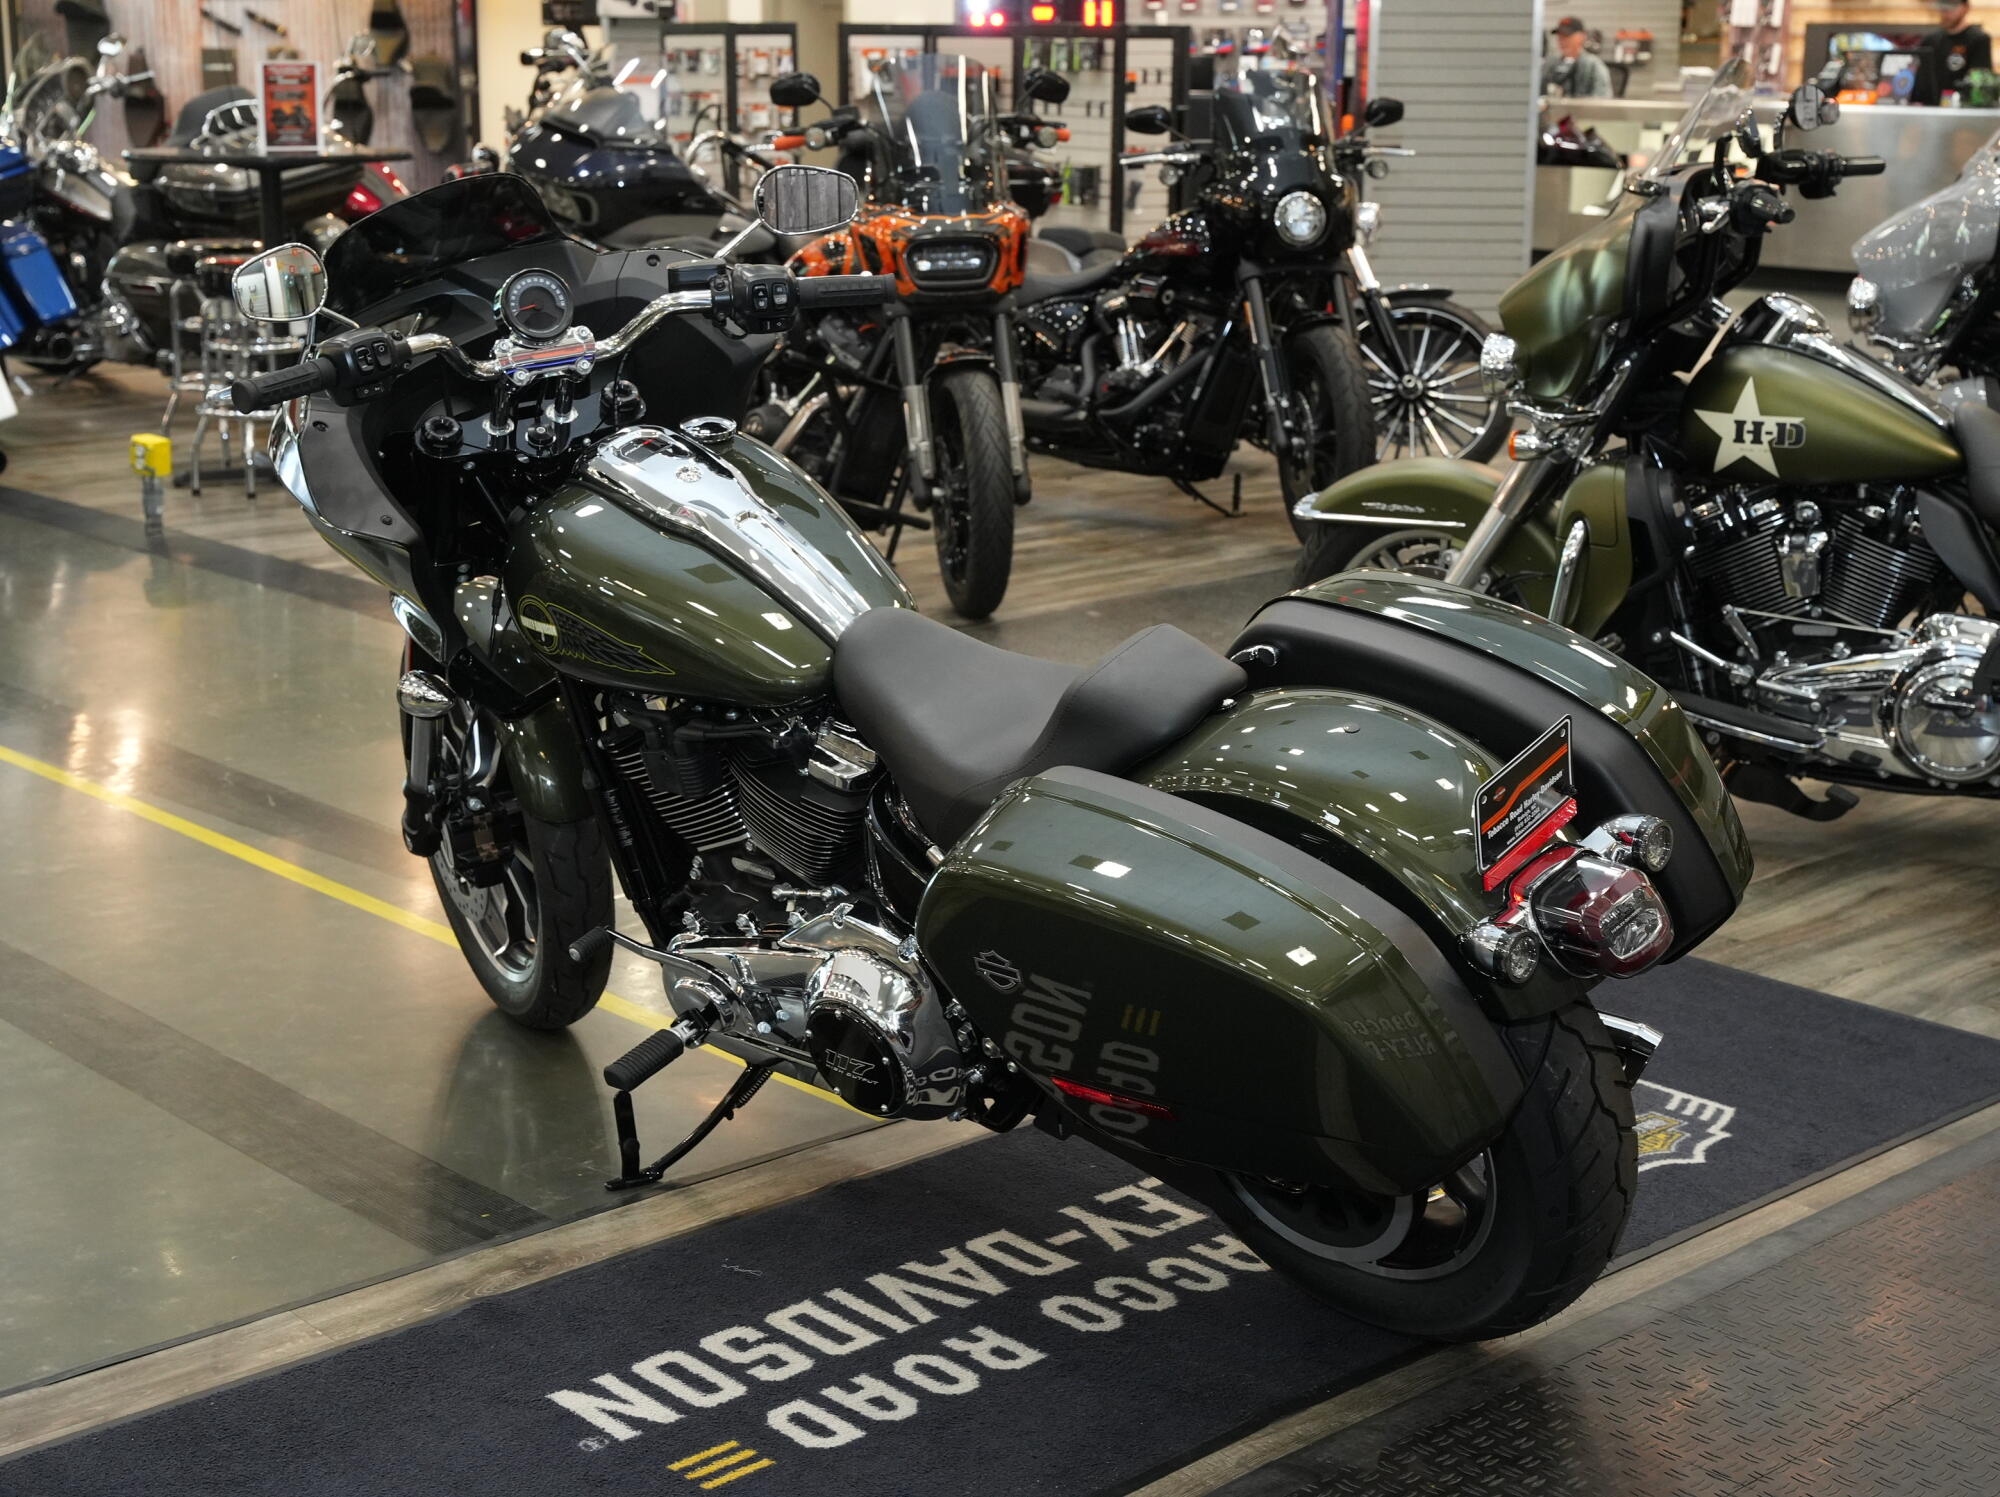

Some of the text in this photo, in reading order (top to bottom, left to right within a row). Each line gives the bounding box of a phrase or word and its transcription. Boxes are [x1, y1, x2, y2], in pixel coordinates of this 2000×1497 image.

[1733, 419, 1806, 448] H-D
[1487, 817, 1510, 840] Tobacco
[1509, 803, 1524, 821] Road
[825, 1048, 875, 1076] 117
[766, 1325, 1048, 1449] ROAD
